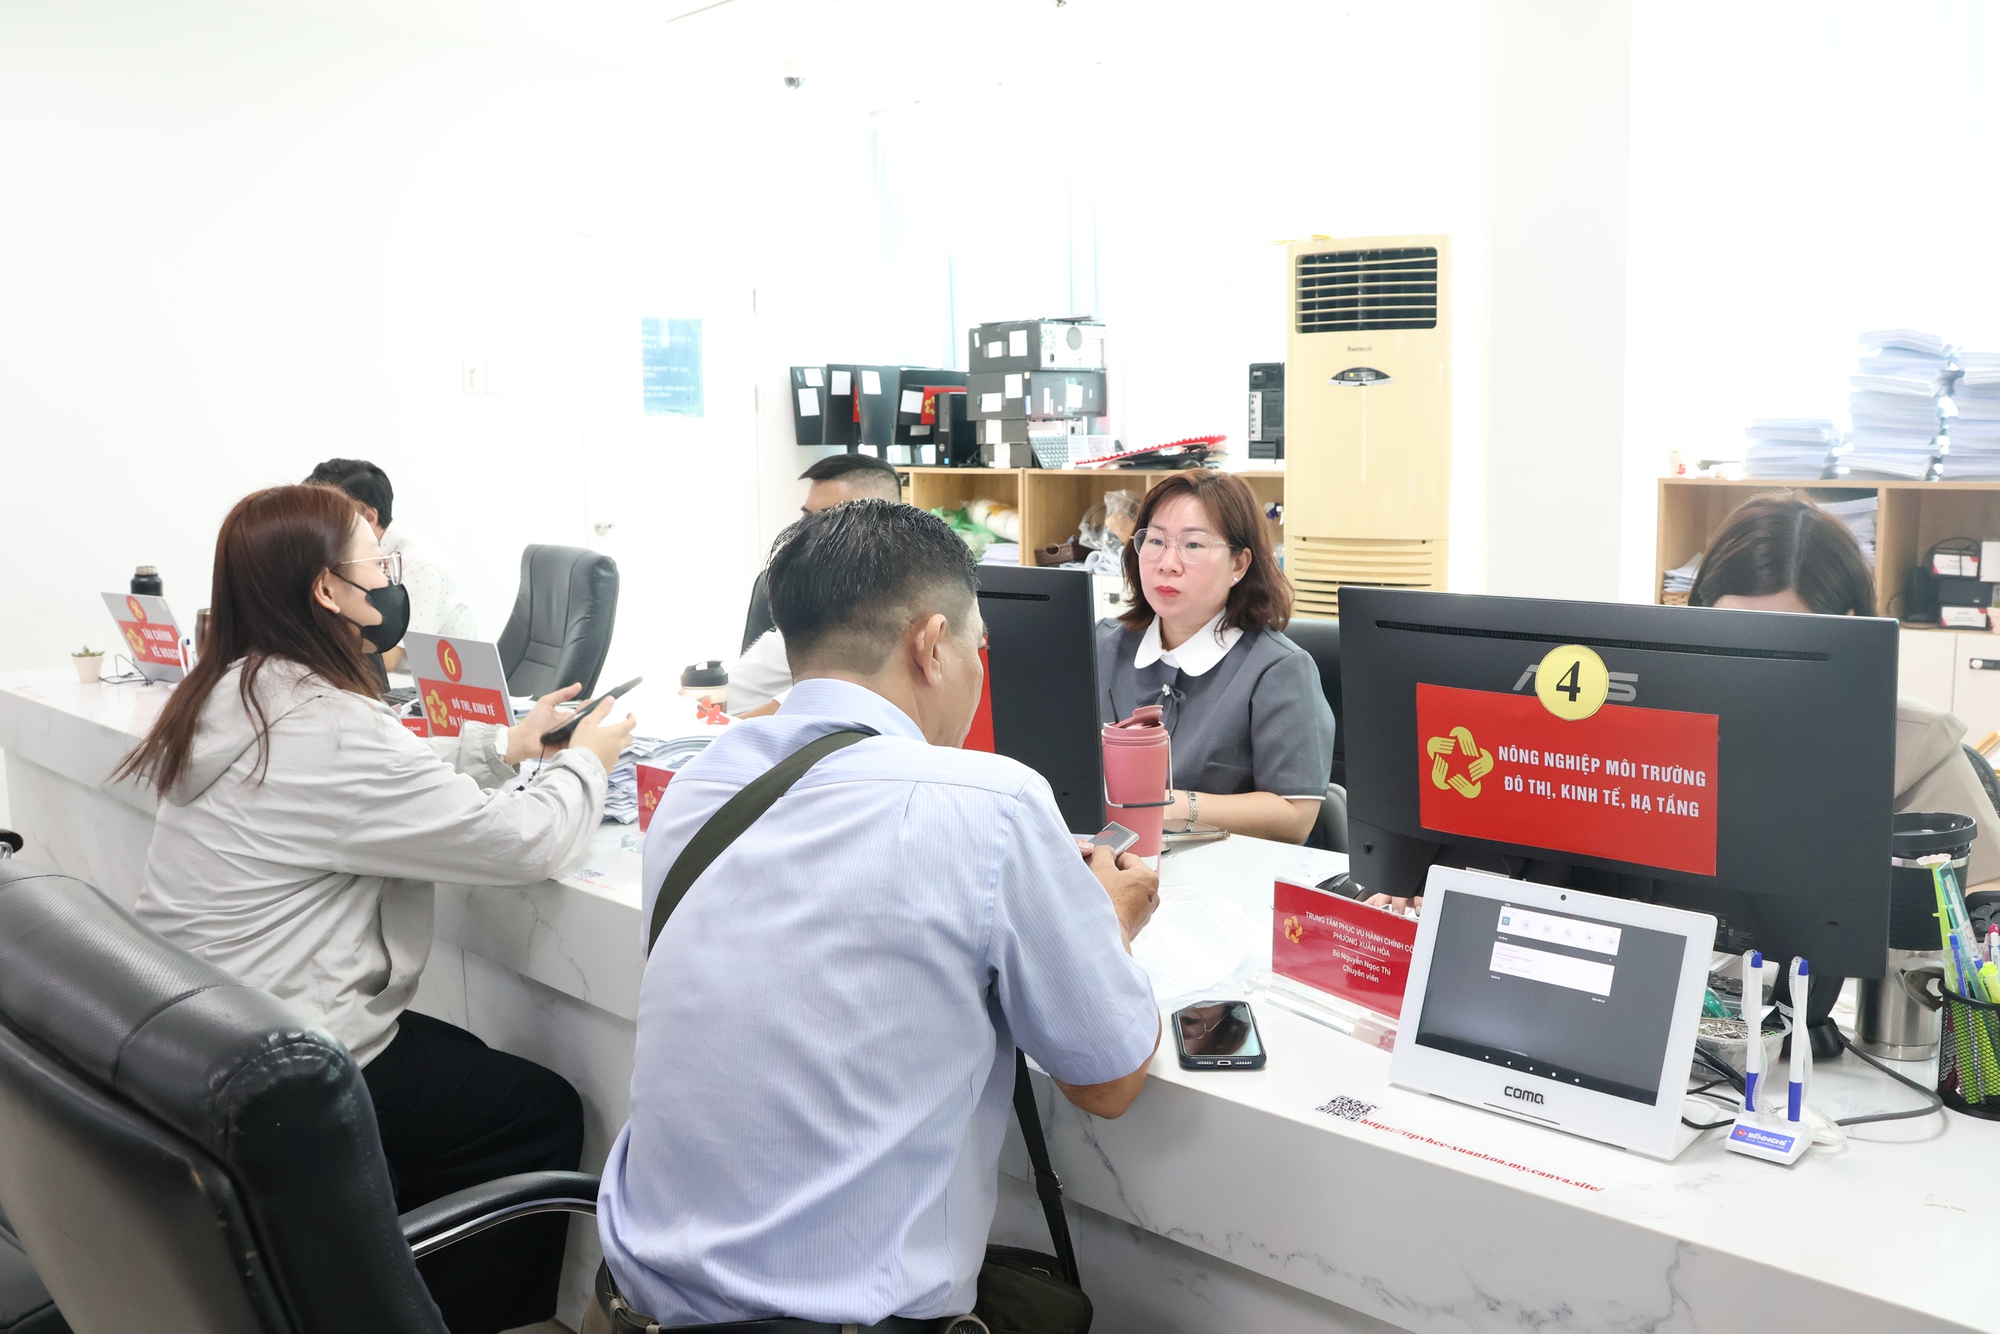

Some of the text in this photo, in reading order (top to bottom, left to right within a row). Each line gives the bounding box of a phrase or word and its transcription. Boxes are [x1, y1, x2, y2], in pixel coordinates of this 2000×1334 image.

[130, 600, 143, 619] 8
[443, 647, 457, 675] 6
[1556, 660, 1582, 702] 4
[471, 701, 488, 716] KINH
[1498, 744, 1706, 787] NÔNG NGHIỆP MÔI TRƯỜNG
[1504, 774, 1699, 818] ĐÔ THỊ, KINH TẾ, HẠ TẦNG
[1305, 911, 1325, 923] TRUNG
[1326, 917, 1338, 929] TÂM
[1338, 922, 1355, 935] PHỤC
[1356, 928, 1365, 937] VỤ
[1365, 930, 1383, 944] HÀNH
[1383, 935, 1404, 950] CHÍNH
[1333, 931, 1390, 957] PHƯỜNG XUÂN HÒA
[1332, 949, 1341, 958] Bà
[1341, 951, 1364, 966] Nguyễn
[1364, 961, 1380, 973] Ngọc
[1343, 964, 1379, 983] Chuyên viên
[1360, 1118, 1605, 1193] https://ttpvhcc-xuanhoa.my.canva.site/
